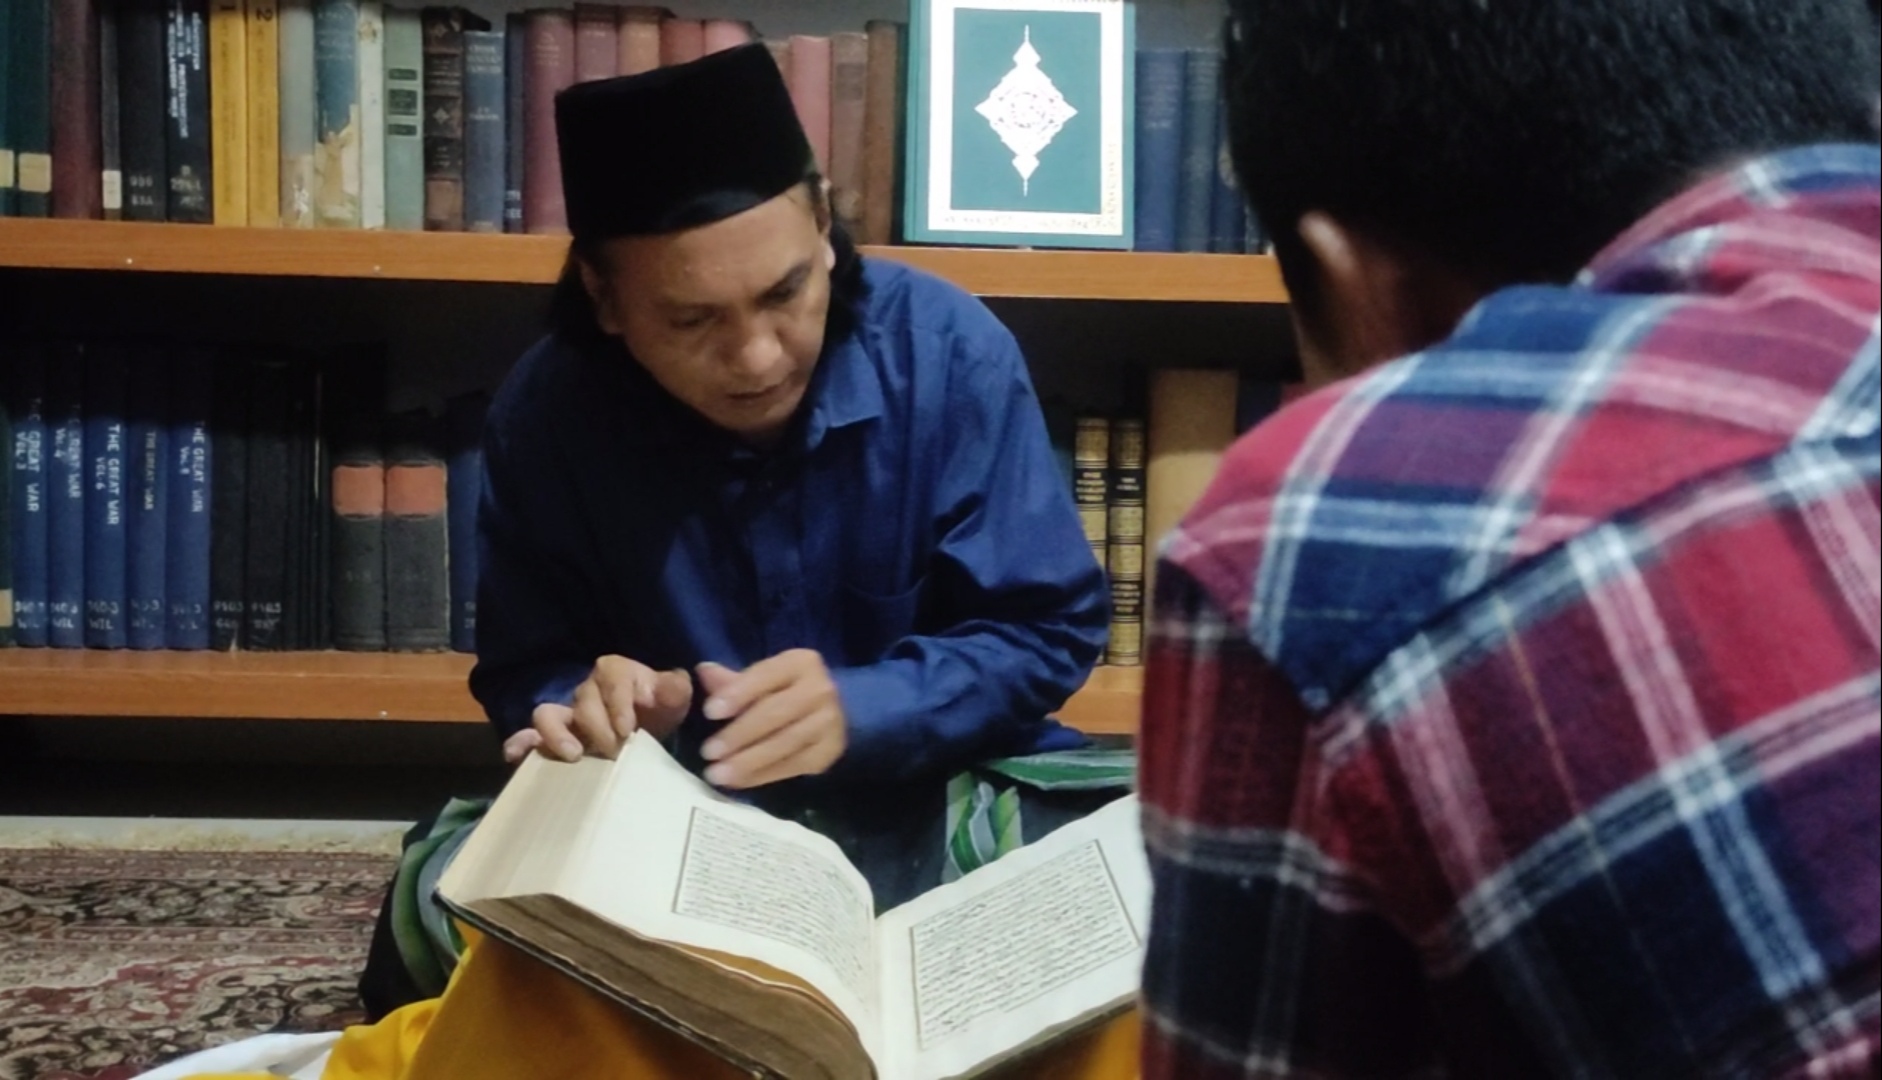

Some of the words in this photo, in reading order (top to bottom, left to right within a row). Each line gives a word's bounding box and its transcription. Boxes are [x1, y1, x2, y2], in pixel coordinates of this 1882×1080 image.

[256, 8, 273, 21] 2
[107, 424, 120, 451] THE
[193, 421, 205, 443] THE
[28, 431, 41, 472] GREAT
[68, 430, 81, 469] GREAT
[107, 458, 120, 495] GREAT
[193, 447, 204, 482] GREAT
[27, 483, 40, 512] WAR
[68, 473, 82, 498] WAR
[144, 487, 154, 510] WAR
[191, 489, 203, 512] WAR
[107, 500, 120, 525] WAR
[89, 618, 115, 630] WIL
